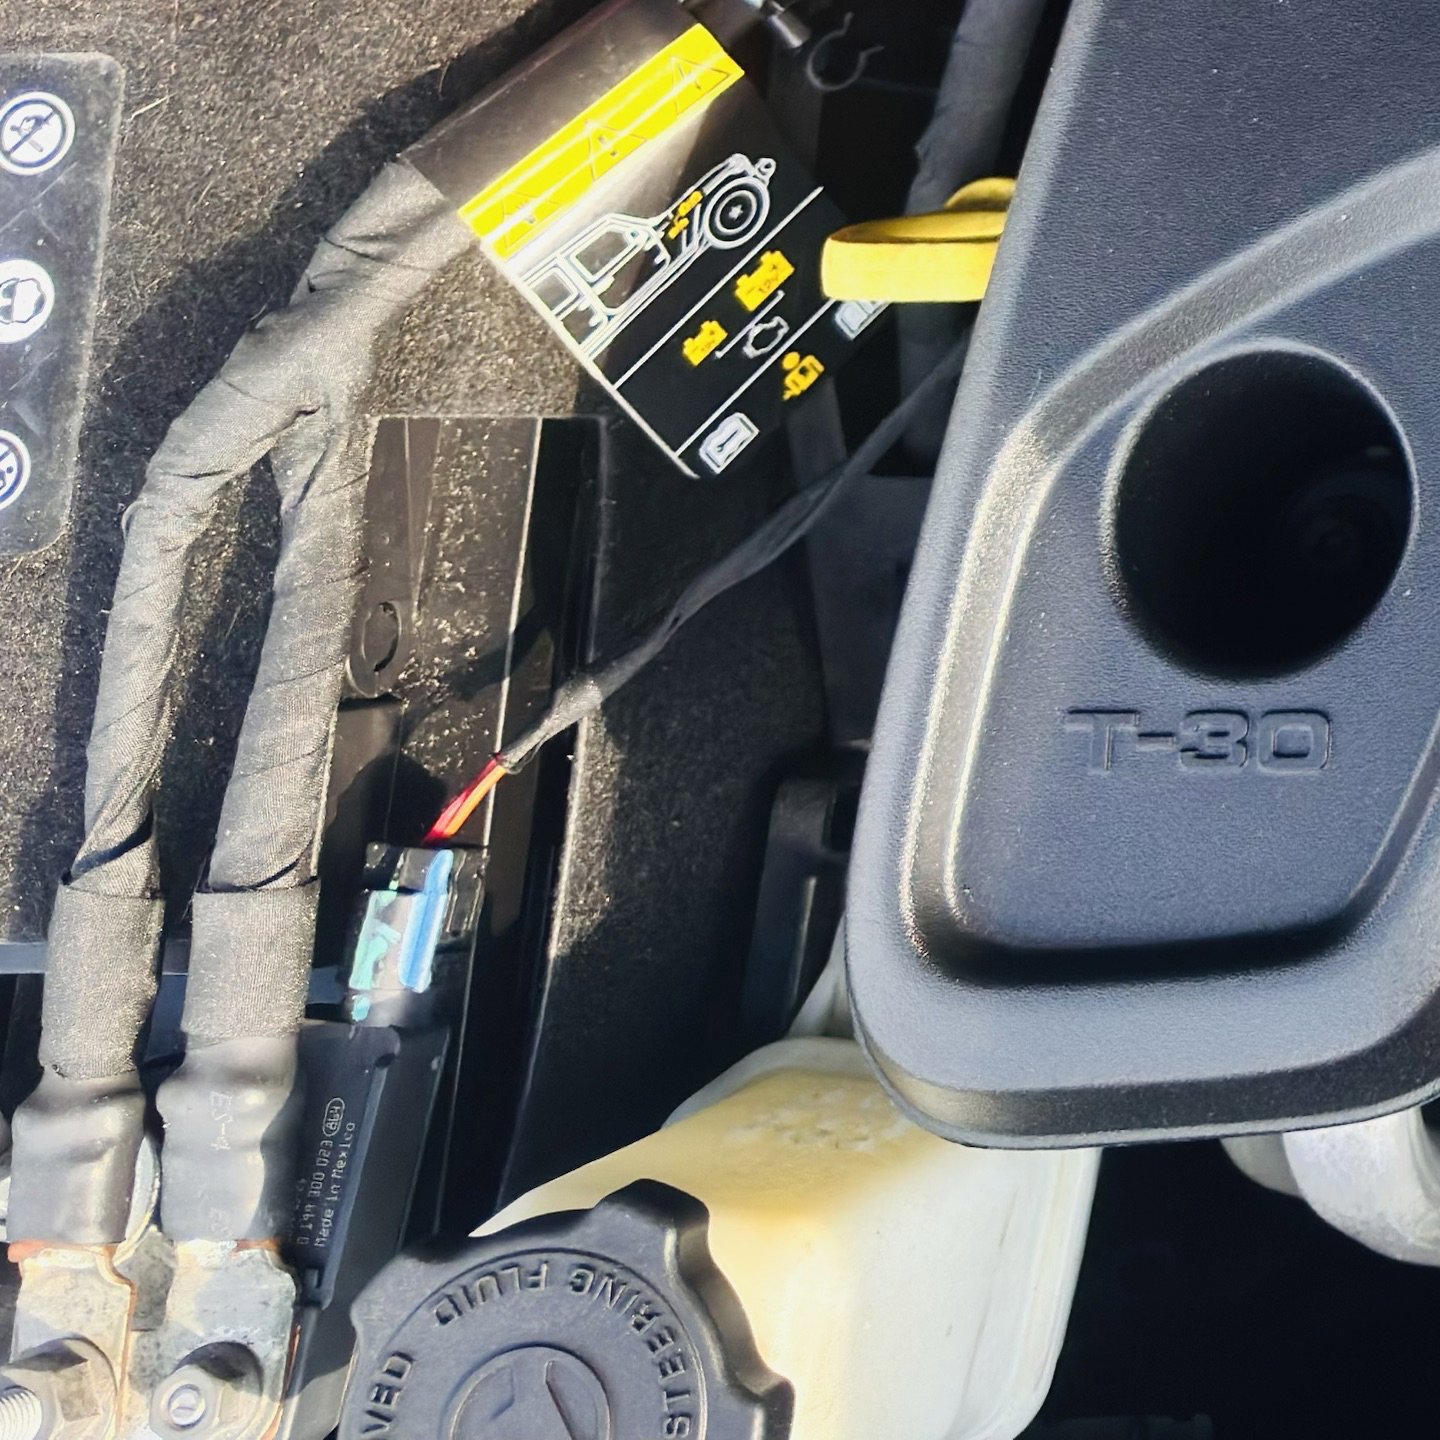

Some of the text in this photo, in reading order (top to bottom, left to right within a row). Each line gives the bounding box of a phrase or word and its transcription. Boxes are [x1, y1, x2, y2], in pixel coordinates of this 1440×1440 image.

[1063, 705, 1334, 777] T-30
[313, 1208, 335, 1248] Made
[331, 1122, 356, 1179] Mexico
[432, 1258, 693, 1439] STEERING FLUID
